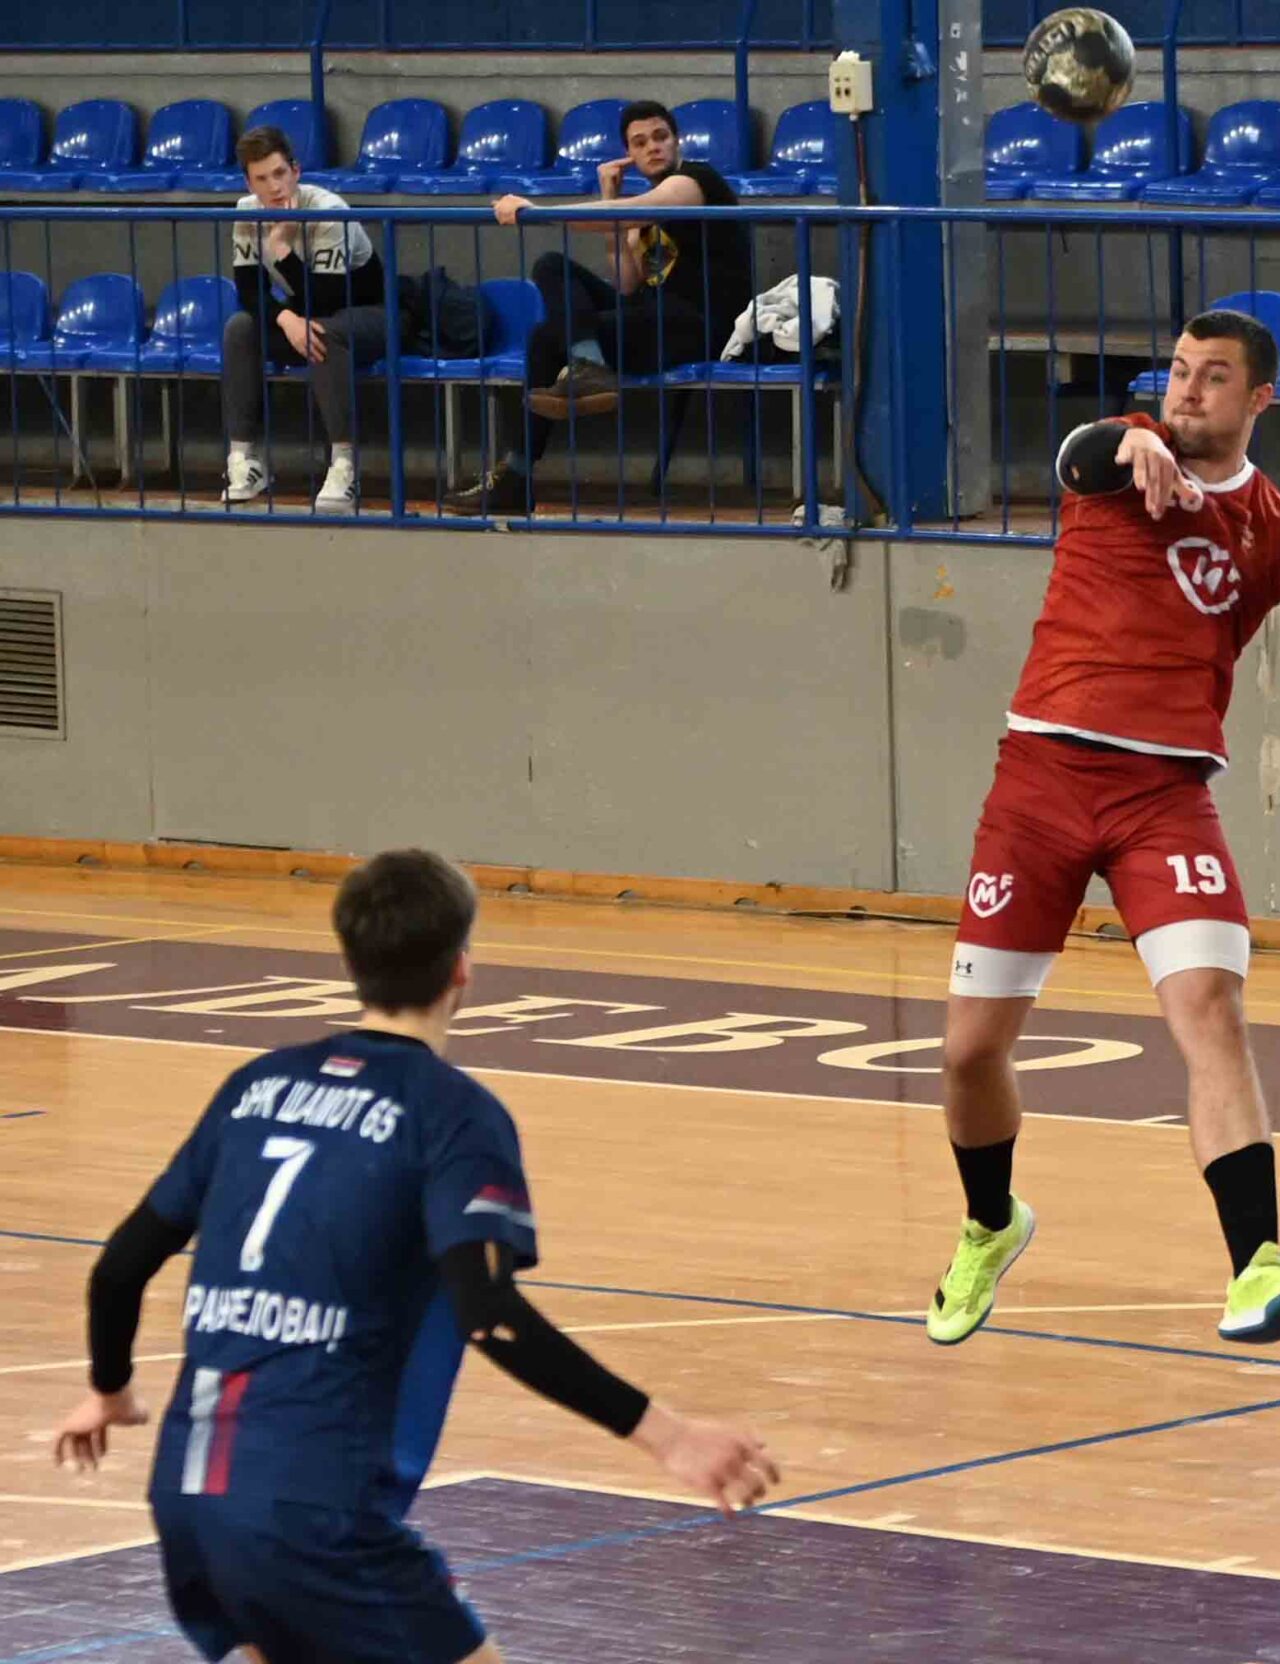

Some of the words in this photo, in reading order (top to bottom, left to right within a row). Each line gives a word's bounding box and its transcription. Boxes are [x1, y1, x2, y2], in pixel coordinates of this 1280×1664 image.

[1166, 854, 1226, 895] 19
[359, 1097, 404, 1143] 65
[239, 1136, 317, 1272] 7
